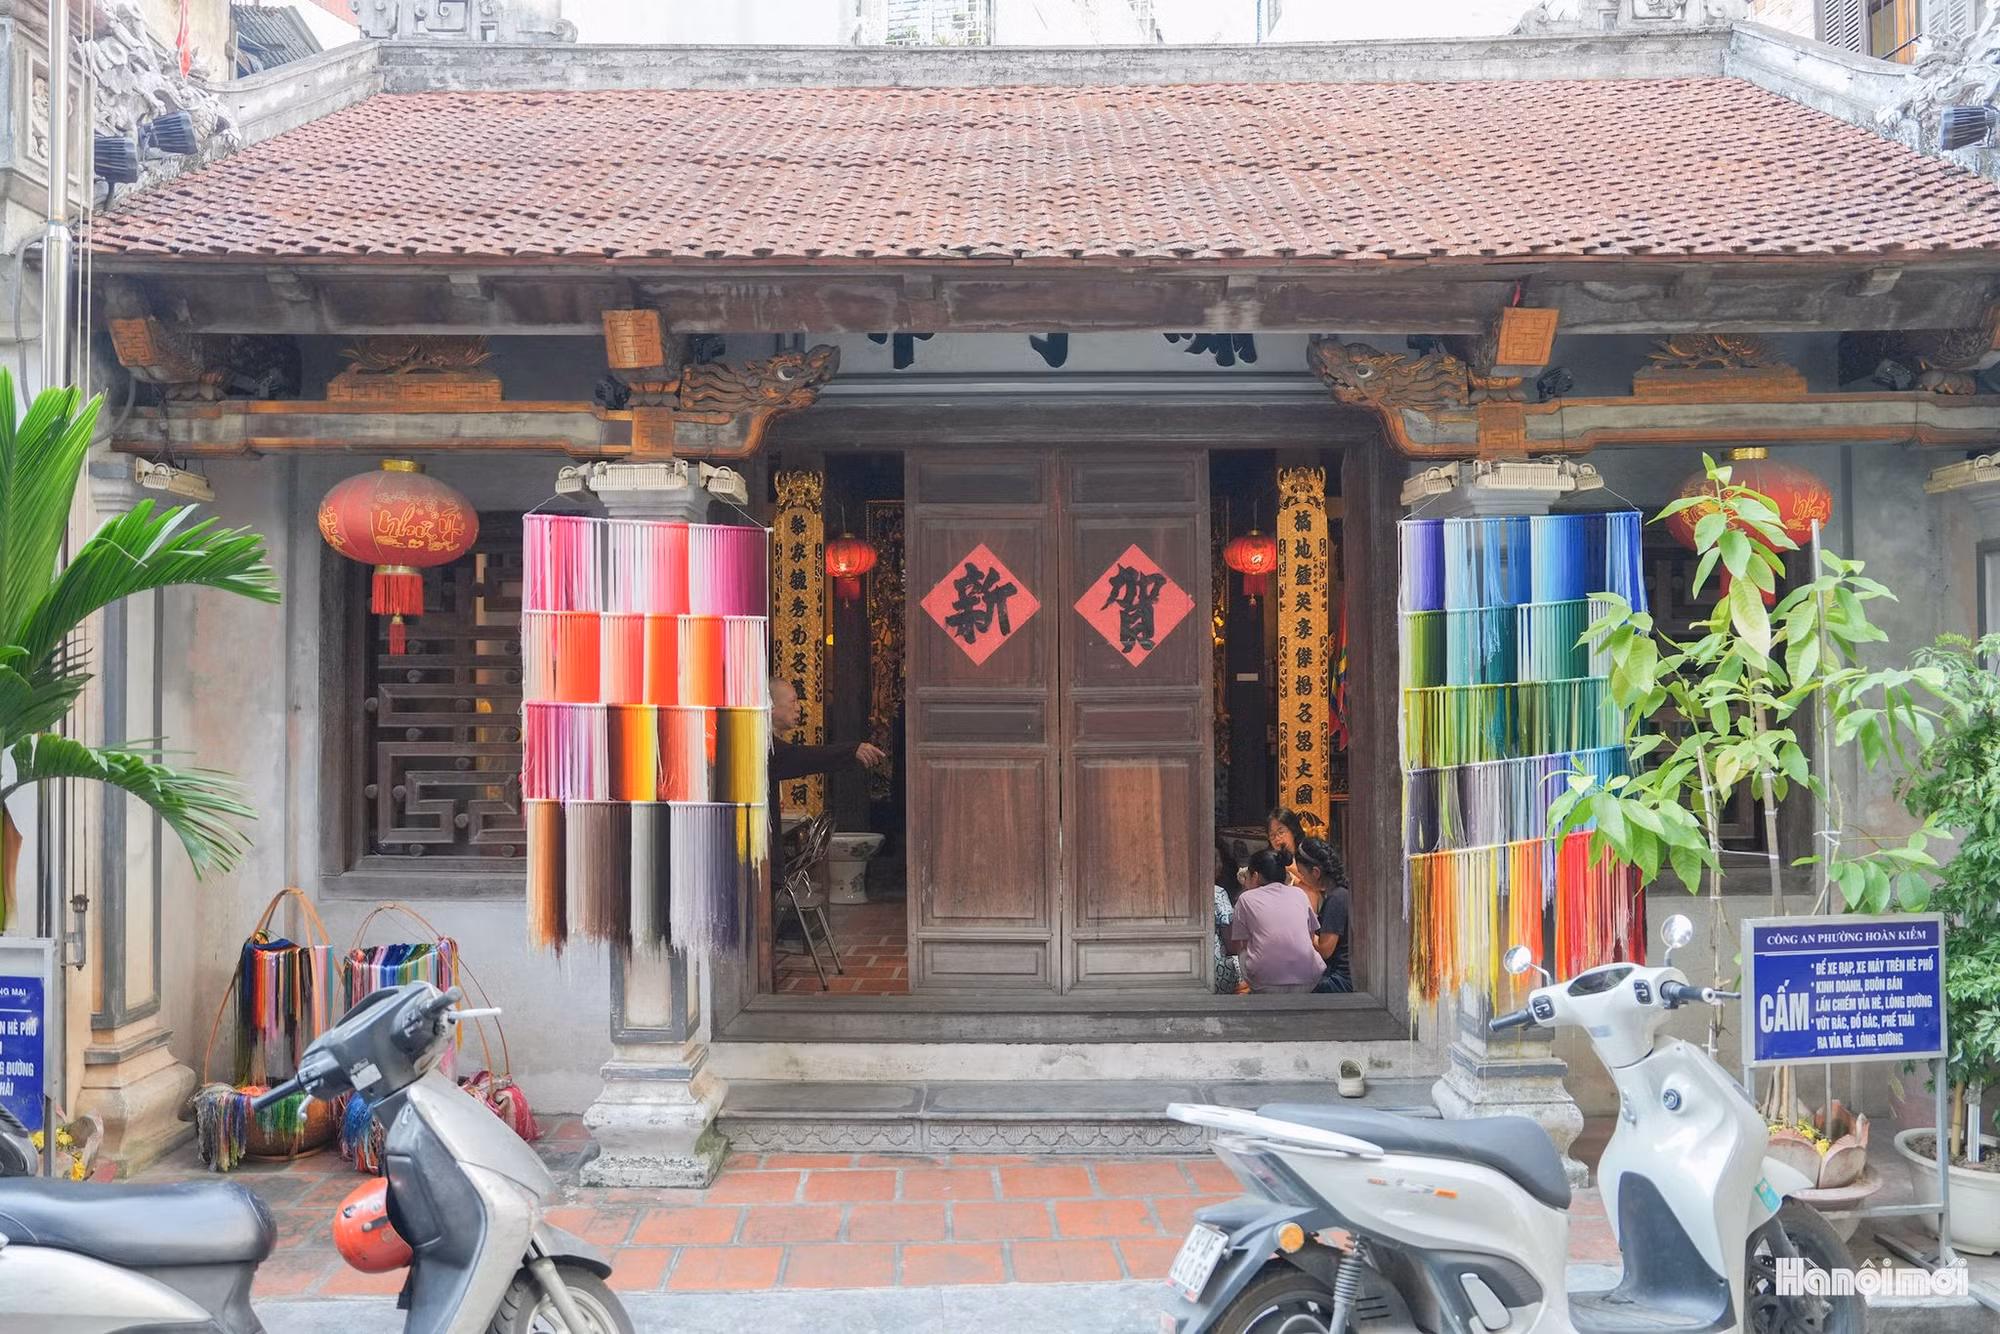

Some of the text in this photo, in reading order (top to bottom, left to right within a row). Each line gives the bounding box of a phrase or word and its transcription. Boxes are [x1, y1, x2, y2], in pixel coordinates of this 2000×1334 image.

[945, 562, 1018, 644] 新
[1100, 563, 1167, 653] 賀
[1766, 925, 1926, 945] CÔNG AN PHƯỜNG HOÀN KIẾM
[1827, 962, 1838, 975] XE
[1838, 961, 1855, 977] ĐẠP,
[1856, 960, 1867, 974] XE
[1867, 957, 1885, 973] MÁY
[1885, 957, 1905, 972] TRÊN
[1906, 956, 1917, 972] HÈ
[1918, 953, 1934, 972] PHỐ
[11, 987, 27, 997] MẠI
[1815, 975, 1903, 994] KINH DOANH, BUÔN BÁN
[1760, 979, 1810, 1033] CẤM
[1815, 992, 1933, 1012] LẤN CHIẾM VỈA HÈ, LÒNG ĐƯỜNG
[7, 1018, 19, 1036] HÈ
[1815, 1014, 1830, 1031] VỨT
[1831, 1014, 1849, 1031] RÁC,
[1862, 1012, 1880, 1029] RÁC,
[1881, 1010, 1897, 1027] PHẾ
[1897, 1010, 1915, 1027] THẢI
[1816, 1030, 1904, 1050] RA VỈA HÈ, LÒNG ĐƯỜNG
[6, 1058, 34, 1077] ĐƯỜNG
